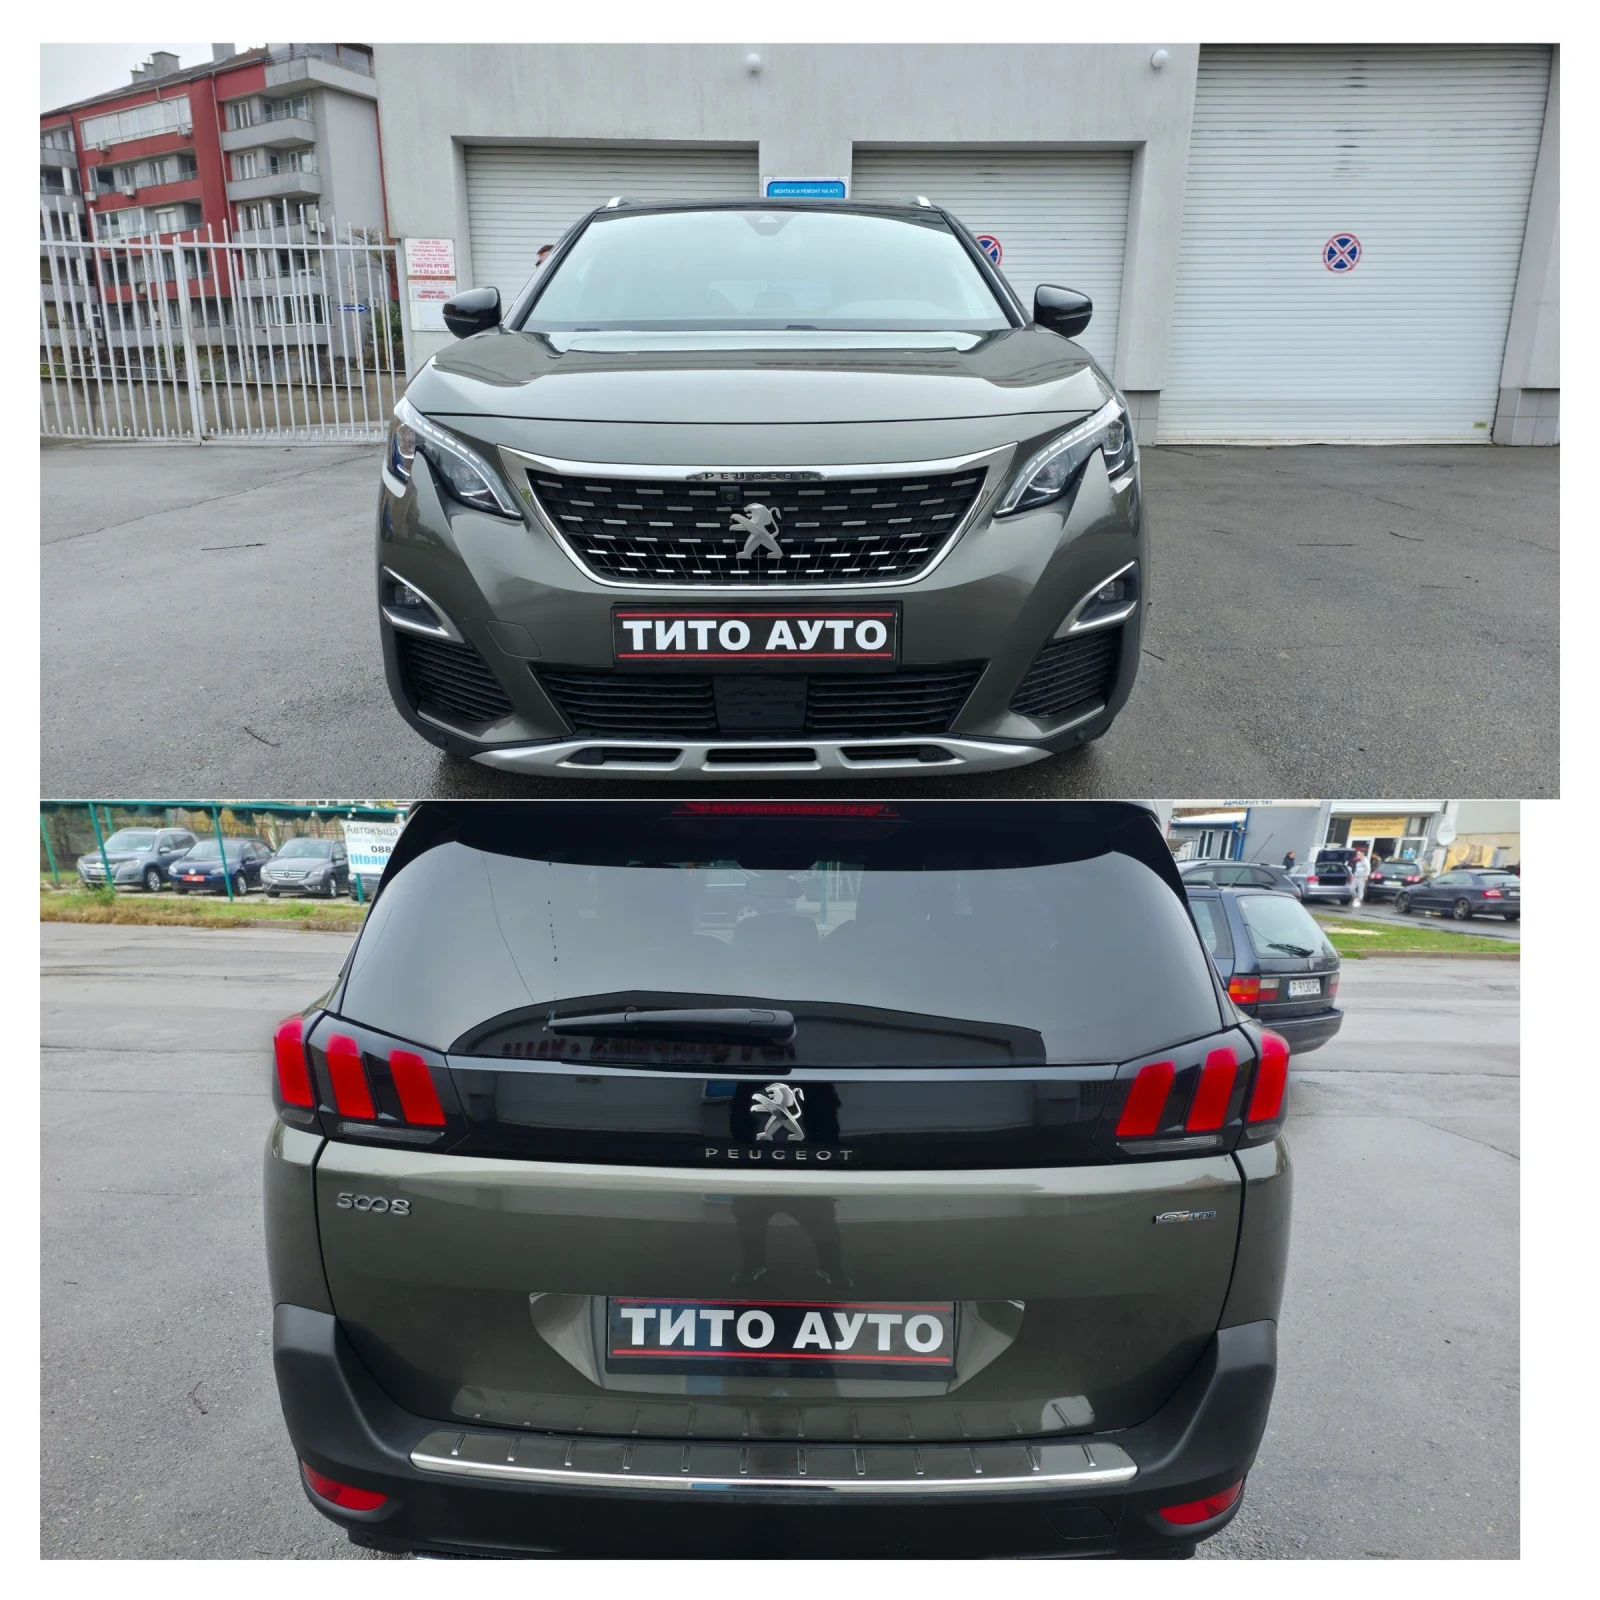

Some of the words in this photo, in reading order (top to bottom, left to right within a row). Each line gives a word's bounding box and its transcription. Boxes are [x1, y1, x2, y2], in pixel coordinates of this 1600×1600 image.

[704, 472, 809, 480] PEUGEOT
[622, 620, 751, 651] ТИТО
[765, 620, 888, 651] АУТО
[346, 824, 398, 837] Автокъща
[371, 845, 394, 853] 088
[705, 1148, 853, 1161] PEUGEOT
[336, 1192, 411, 1216] 5008
[620, 1308, 775, 1349] ТИТО
[792, 1311, 944, 1353] АУТО
